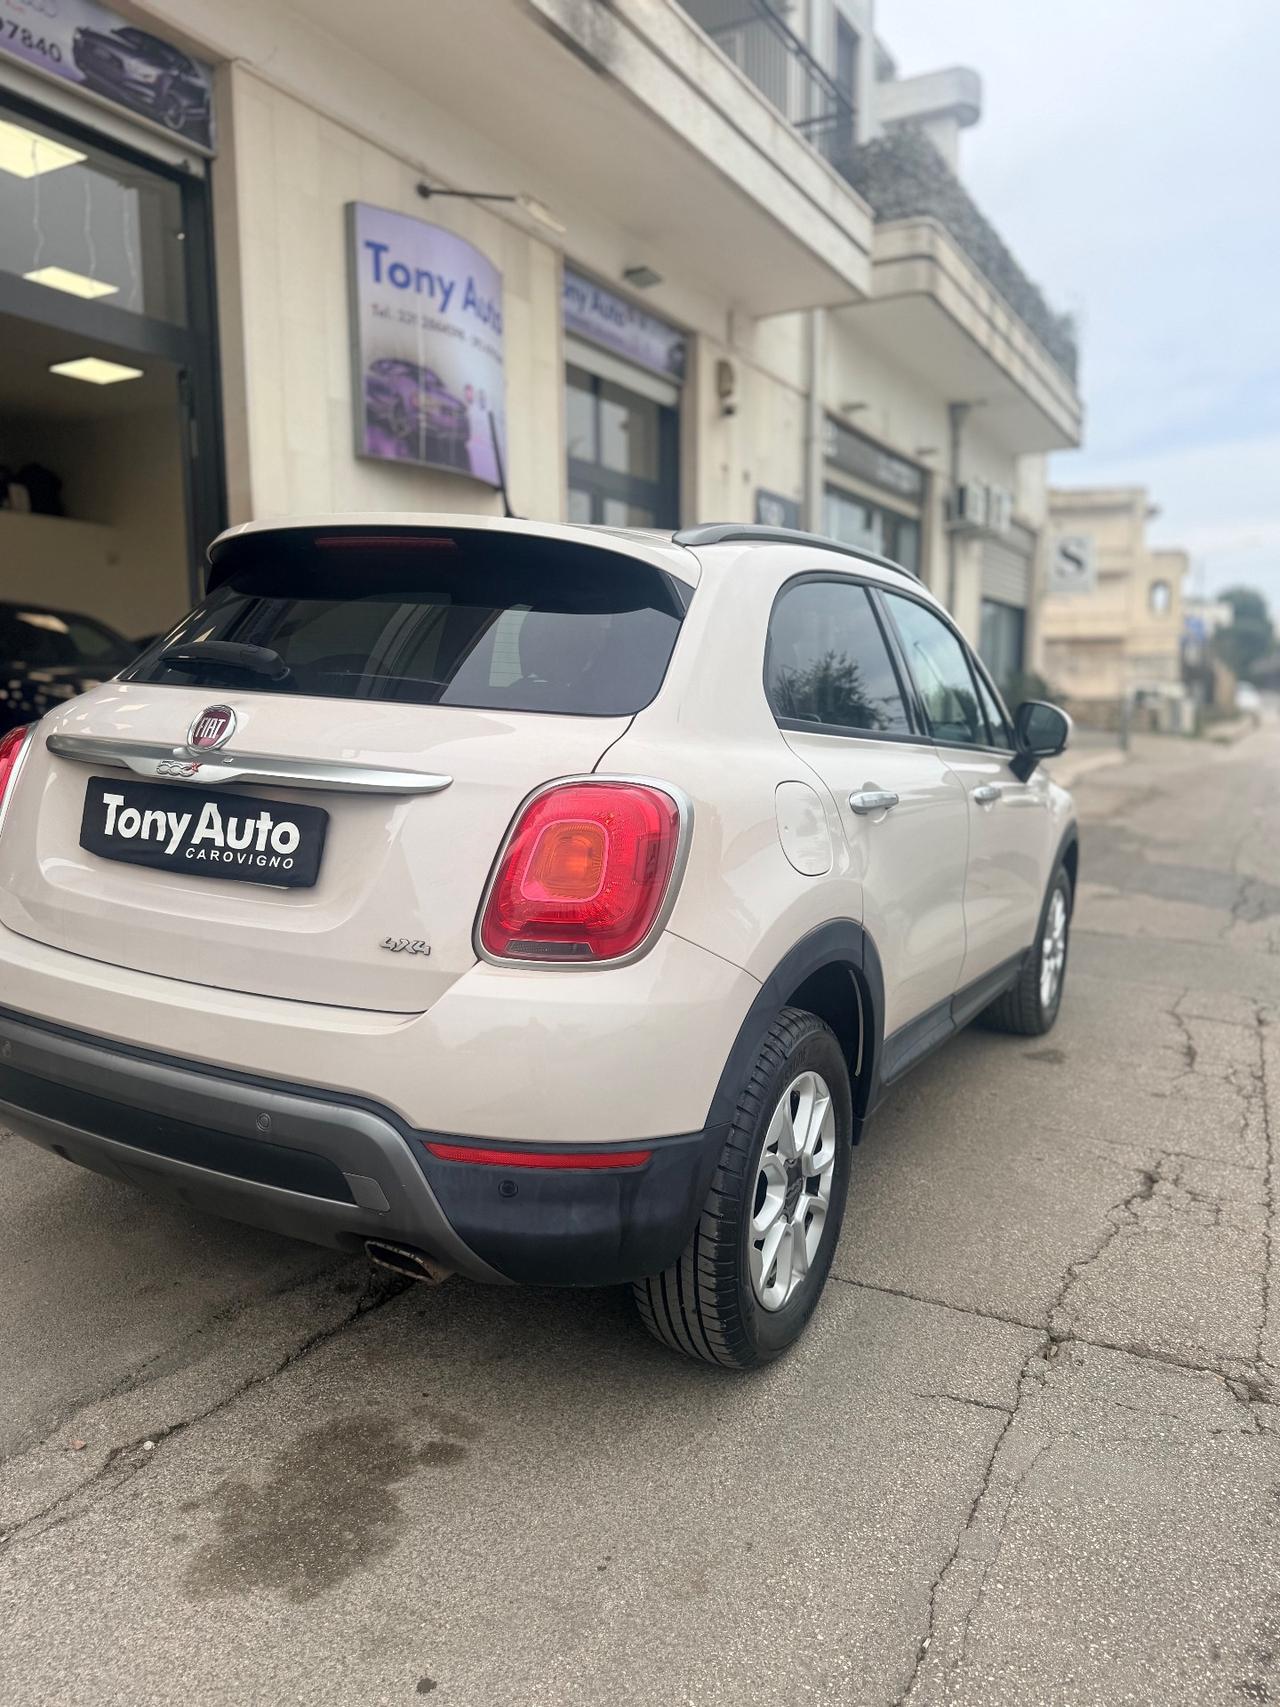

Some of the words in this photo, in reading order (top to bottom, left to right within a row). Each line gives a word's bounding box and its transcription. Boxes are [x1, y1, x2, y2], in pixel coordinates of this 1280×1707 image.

[364, 240, 454, 313] Tony
[1055, 538, 1087, 578] S
[195, 717, 226, 739] FIAT
[103, 792, 192, 855] Tony
[190, 802, 300, 855] Auto
[185, 847, 294, 870] CAROVIGNO
